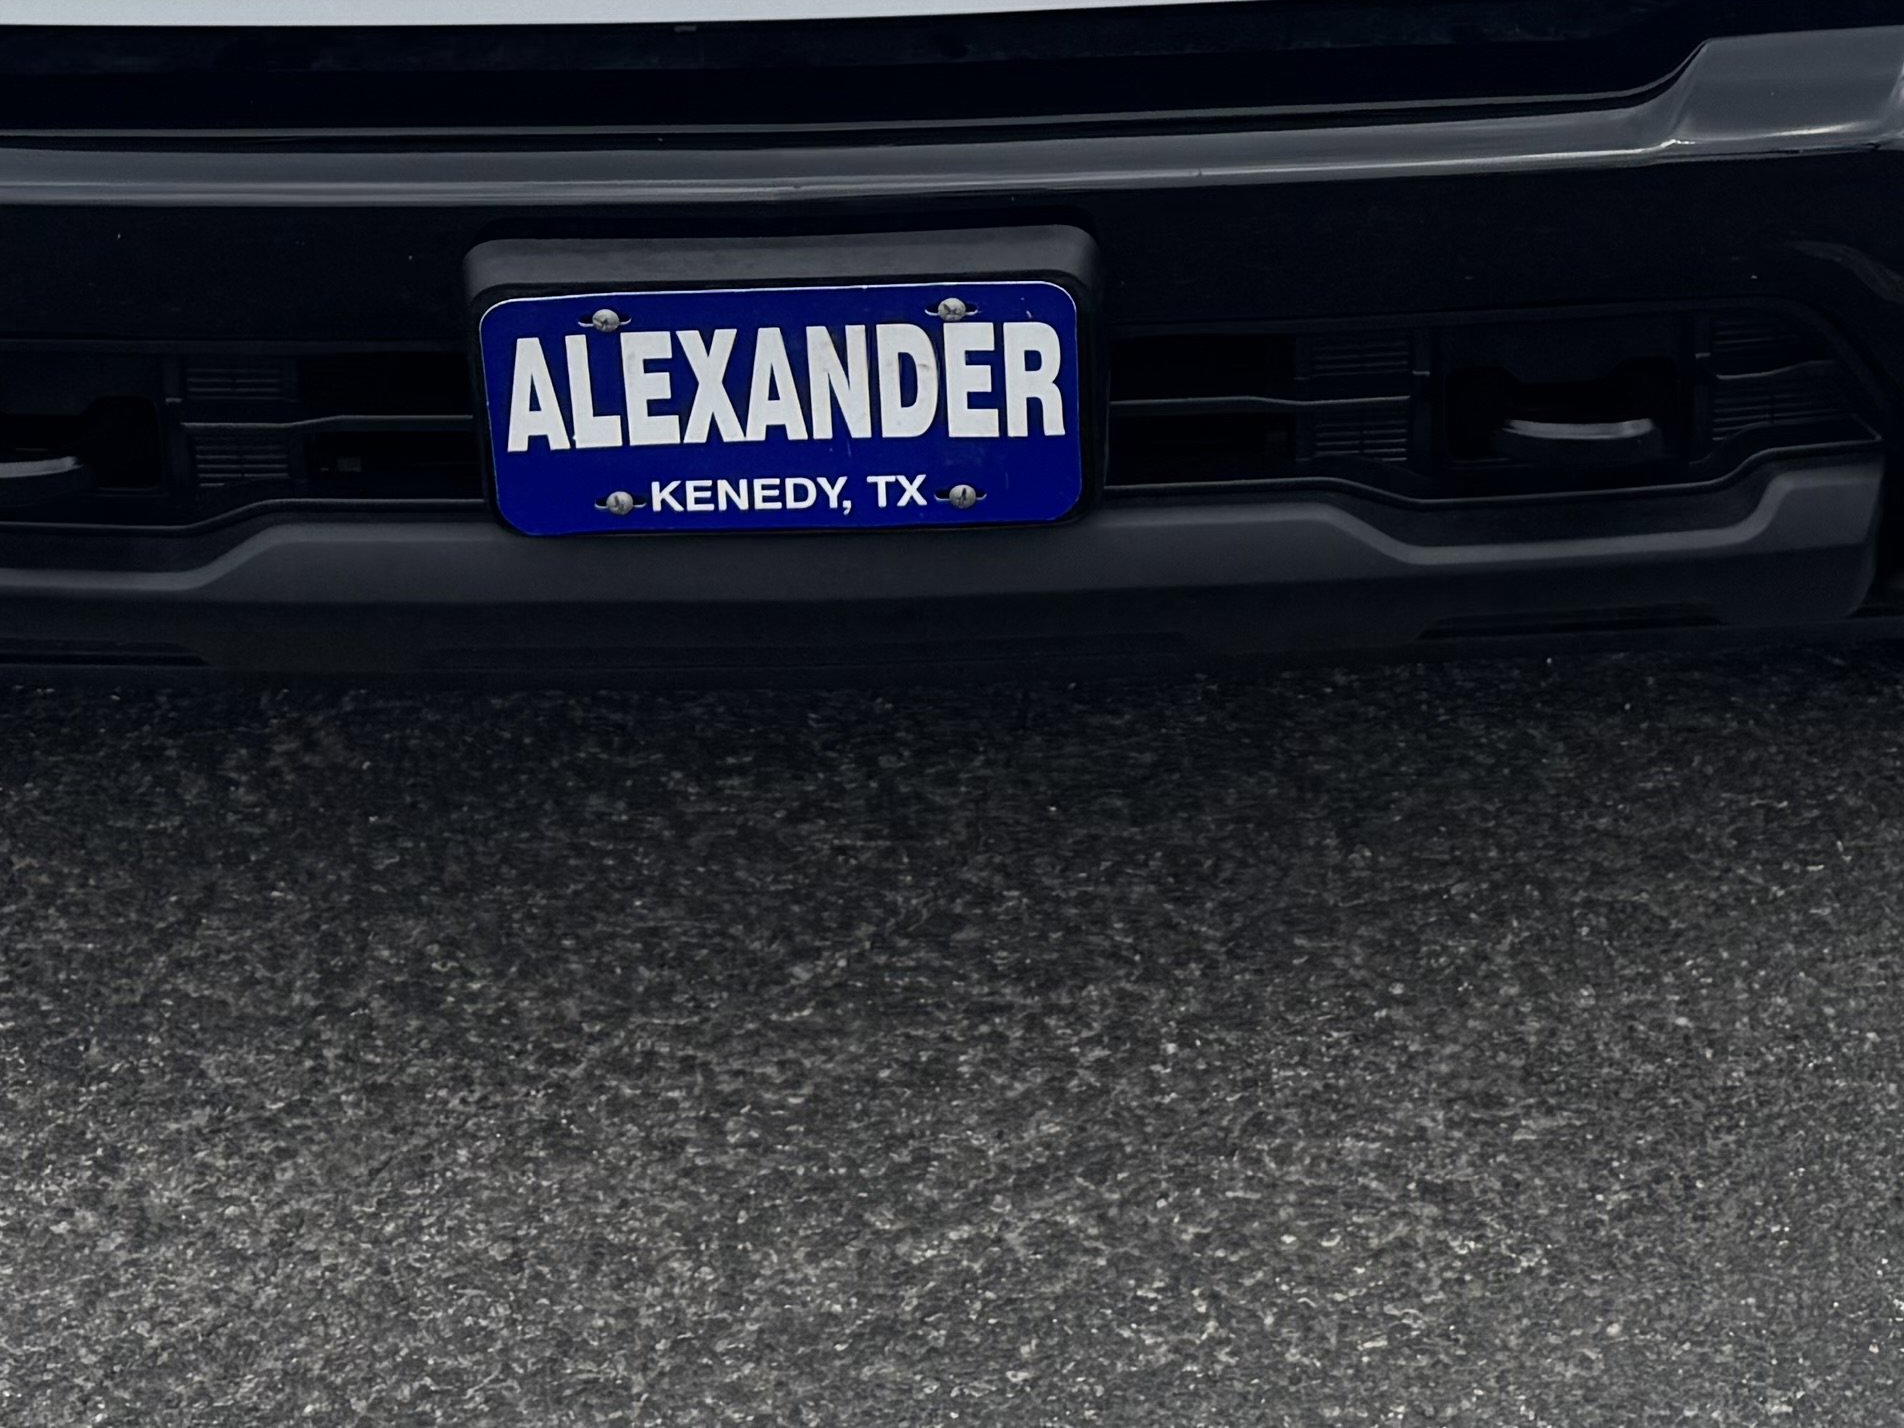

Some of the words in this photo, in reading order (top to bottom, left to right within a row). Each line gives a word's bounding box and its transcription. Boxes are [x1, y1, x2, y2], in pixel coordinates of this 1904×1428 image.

[507, 321, 1066, 453] ALEXANDER
[651, 475, 853, 515] KENEDY,
[866, 474, 928, 508] TX
